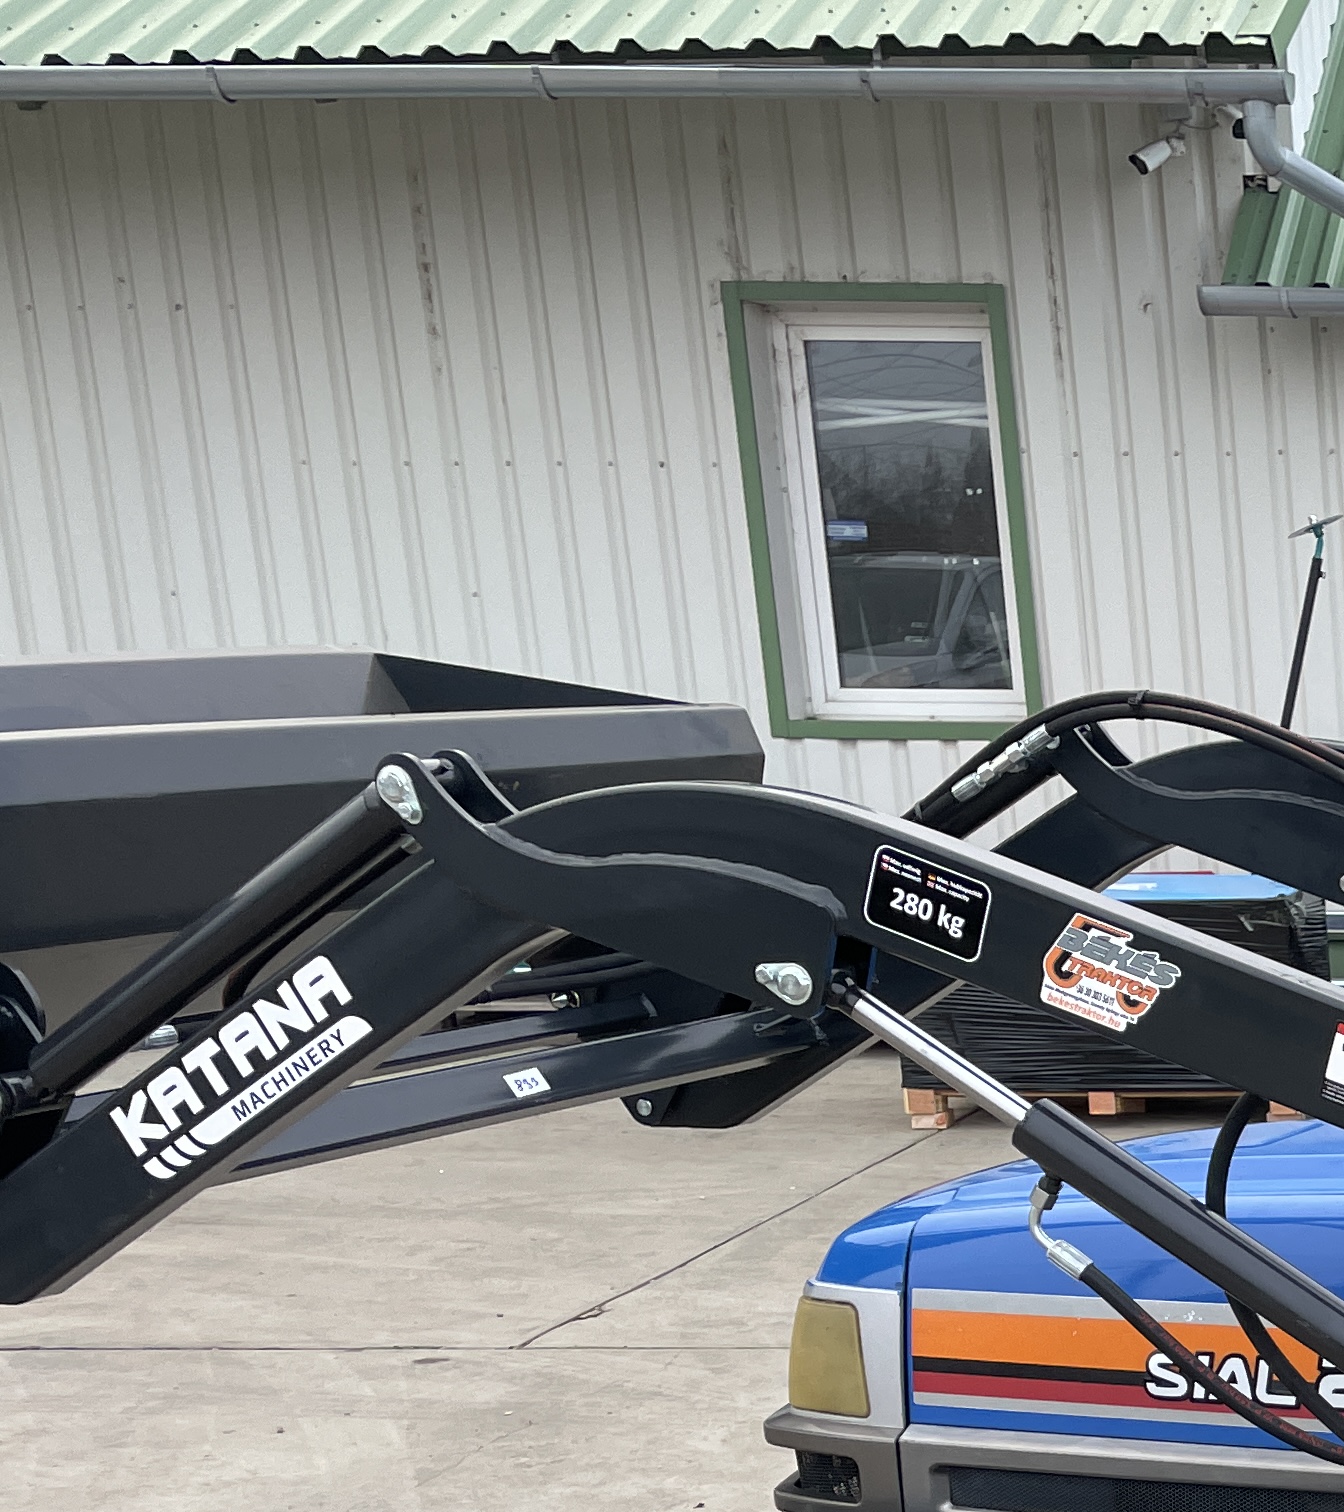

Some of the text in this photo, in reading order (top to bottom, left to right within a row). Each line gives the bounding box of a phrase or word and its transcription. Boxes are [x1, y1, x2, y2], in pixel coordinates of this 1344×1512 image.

[889, 887, 965, 938] 280 kg
[1057, 926, 1179, 987] BÉKÉS
[1067, 955, 1159, 1003] TRAKTOR
[1046, 991, 1121, 1029] bekestraktor.hu
[109, 955, 353, 1157] KATANA
[230, 1028, 346, 1122] MACHINERY
[1145, 1350, 1299, 1407] SIAL
